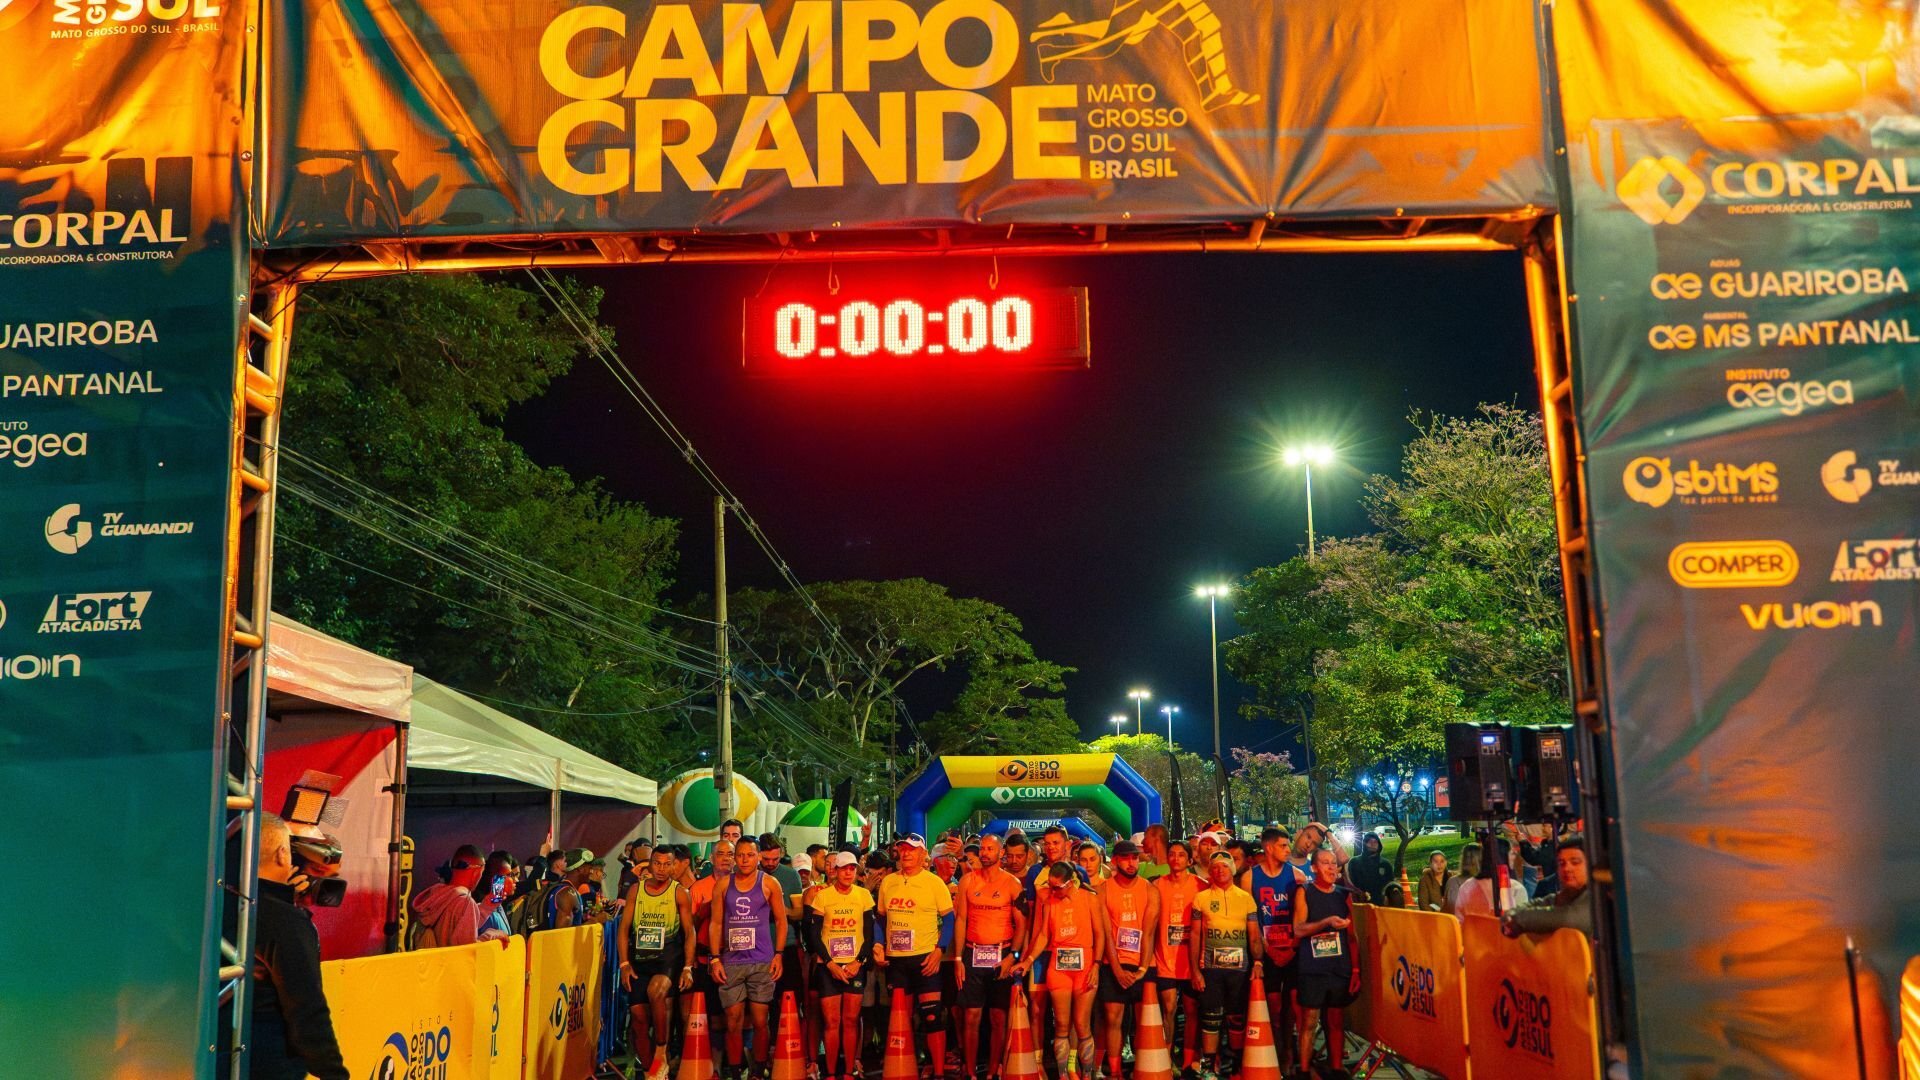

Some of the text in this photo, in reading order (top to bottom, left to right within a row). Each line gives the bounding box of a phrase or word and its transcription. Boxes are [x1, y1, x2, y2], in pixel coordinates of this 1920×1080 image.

[51, 29, 82, 39] MATO
[86, 25, 127, 37] GROSSO
[131, 24, 147, 34] DO
[151, 25, 172, 34] SUL
[182, 22, 219, 33] BRASIL
[539, 0, 1019, 100] CAMPO
[1087, 84, 1156, 103] MATO
[1088, 108, 1187, 128] GROSSO
[537, 85, 1081, 196] GRANDE
[1089, 133, 1176, 154] DO SUL
[1089, 158, 1178, 179] BRASIL
[1711, 158, 1920, 199] CORPAL
[1728, 203, 1820, 215] INCORPORADORA
[1833, 199, 1912, 211] CONSTRUTORA
[86, 253, 94, 262] &
[97, 250, 174, 262] CONSTRUTORA
[1709, 267, 1909, 299] GUARIROBA
[775, 297, 1032, 357] 0:00:00
[1703, 324, 1750, 349] MS
[1758, 319, 1920, 346] PANTANAL
[3, 370, 163, 398] PANTANAL
[1726, 368, 1791, 381] INSTITUTO
[1726, 380, 1854, 416] aegea
[1878, 460, 1900, 473] TV
[1673, 459, 1779, 496] sbtMS
[103, 512, 124, 524] TV
[100, 522, 194, 536] GUANANDI
[1682, 554, 1784, 575] COMPER
[56, 591, 138, 621] Fort
[37, 619, 142, 634] ATACADISTA
[1039, 760, 1060, 770] DO
[1039, 770, 1061, 780] SUL
[1016, 787, 1073, 798] CORPAL
[640, 934, 660, 943] 4071
[1418, 966, 1434, 993] DO
[574, 982, 586, 1009] DO
[1420, 993, 1436, 1018] SUL
[1529, 993, 1551, 1028] DO
[424, 1026, 451, 1067] DO
[1532, 1027, 1554, 1059] SUL
